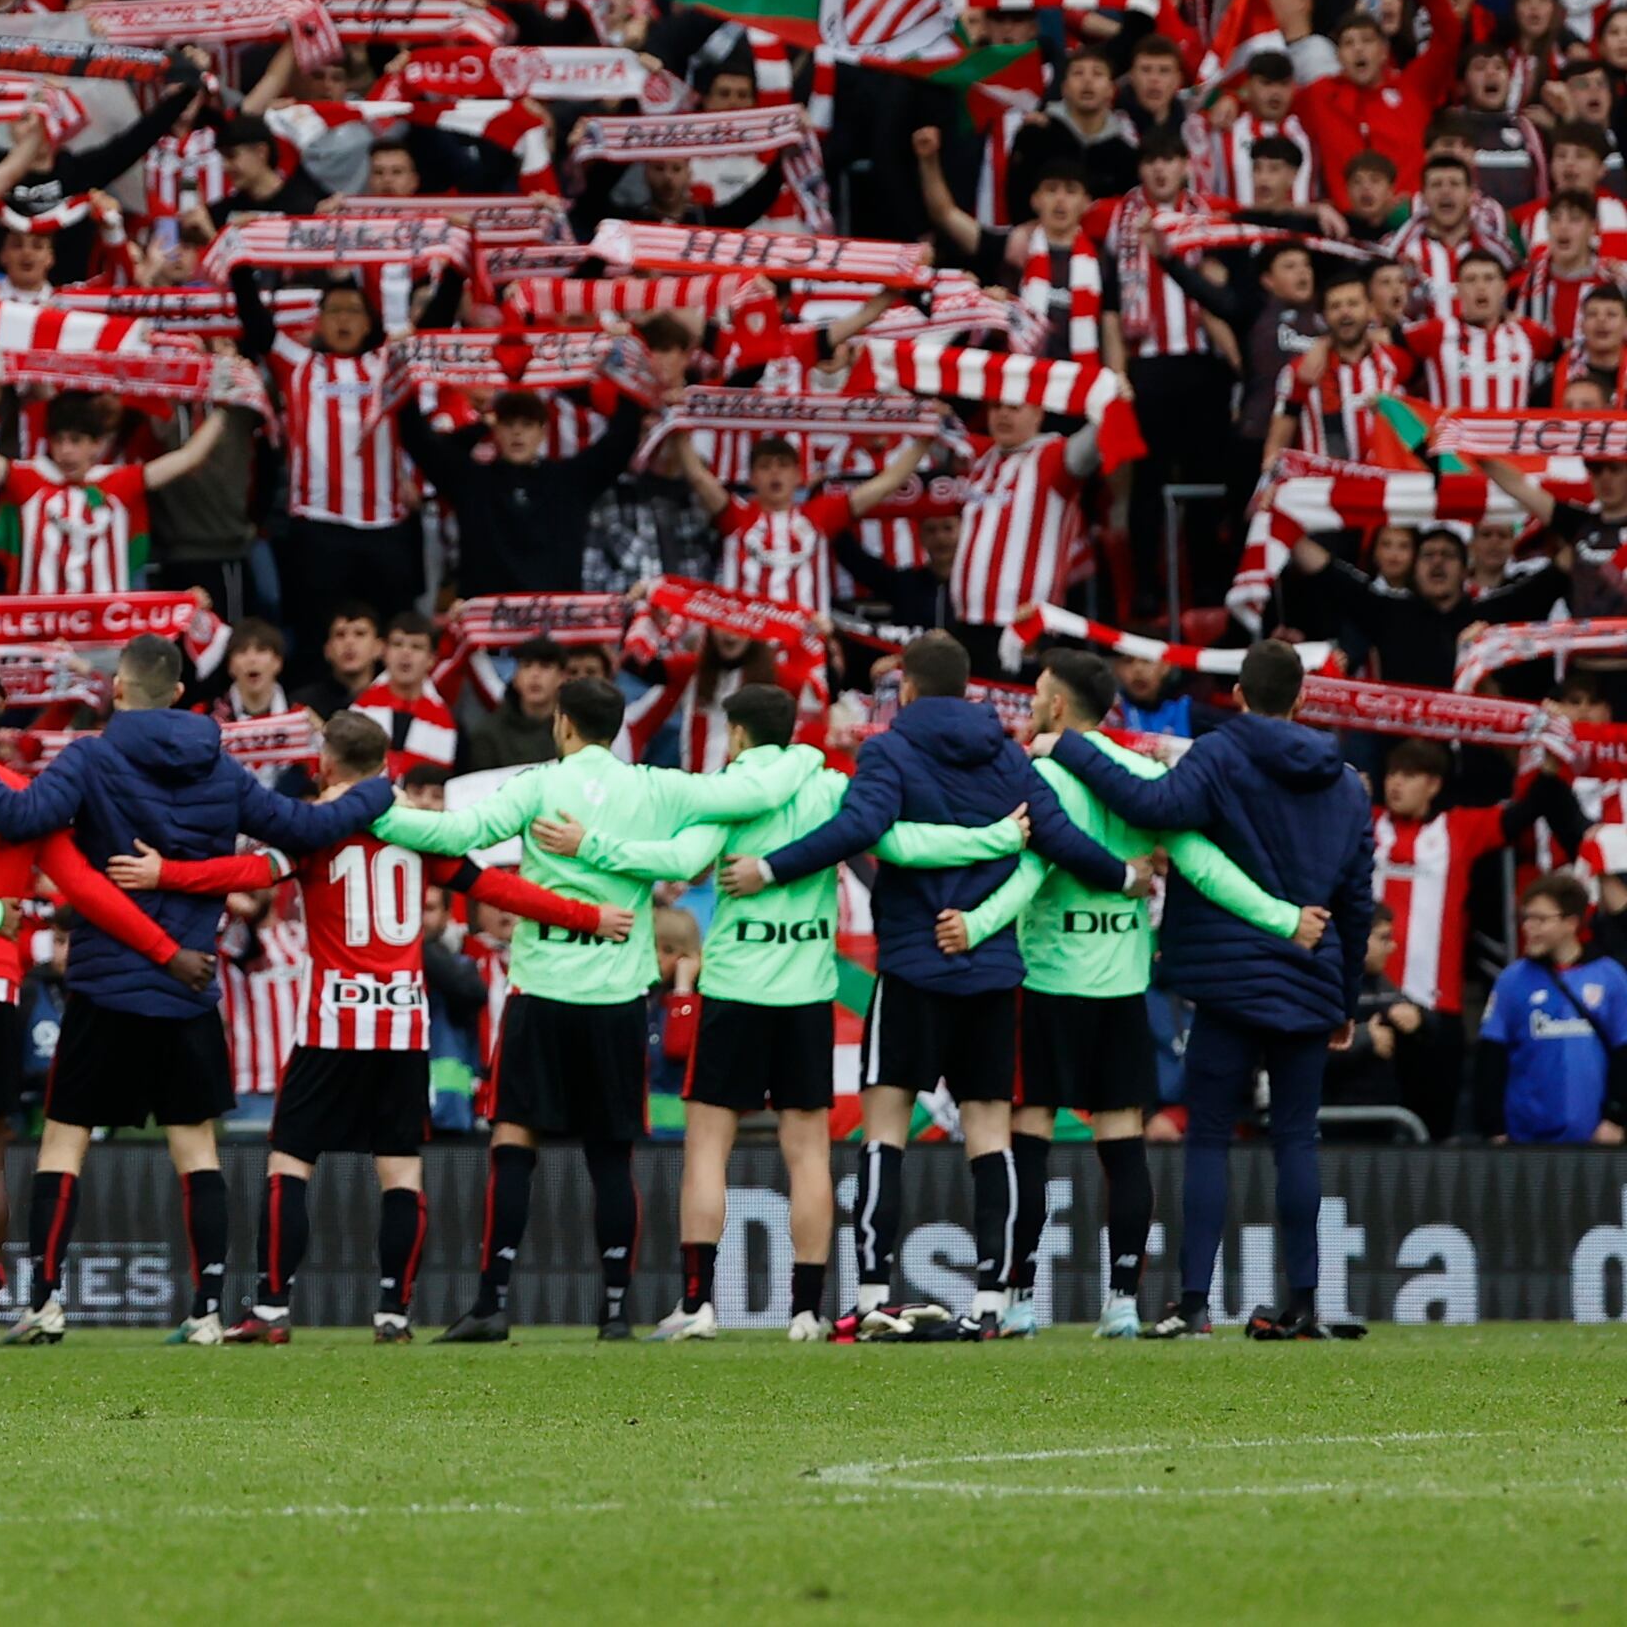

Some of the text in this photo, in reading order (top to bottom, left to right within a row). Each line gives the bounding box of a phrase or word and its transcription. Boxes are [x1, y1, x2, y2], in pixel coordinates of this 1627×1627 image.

[1510, 419, 1627, 454] ICH
[100, 598, 195, 633] CLUB
[328, 843, 424, 949] 10
[736, 918, 832, 945] DIGI
[332, 981, 424, 1007] DIGI
